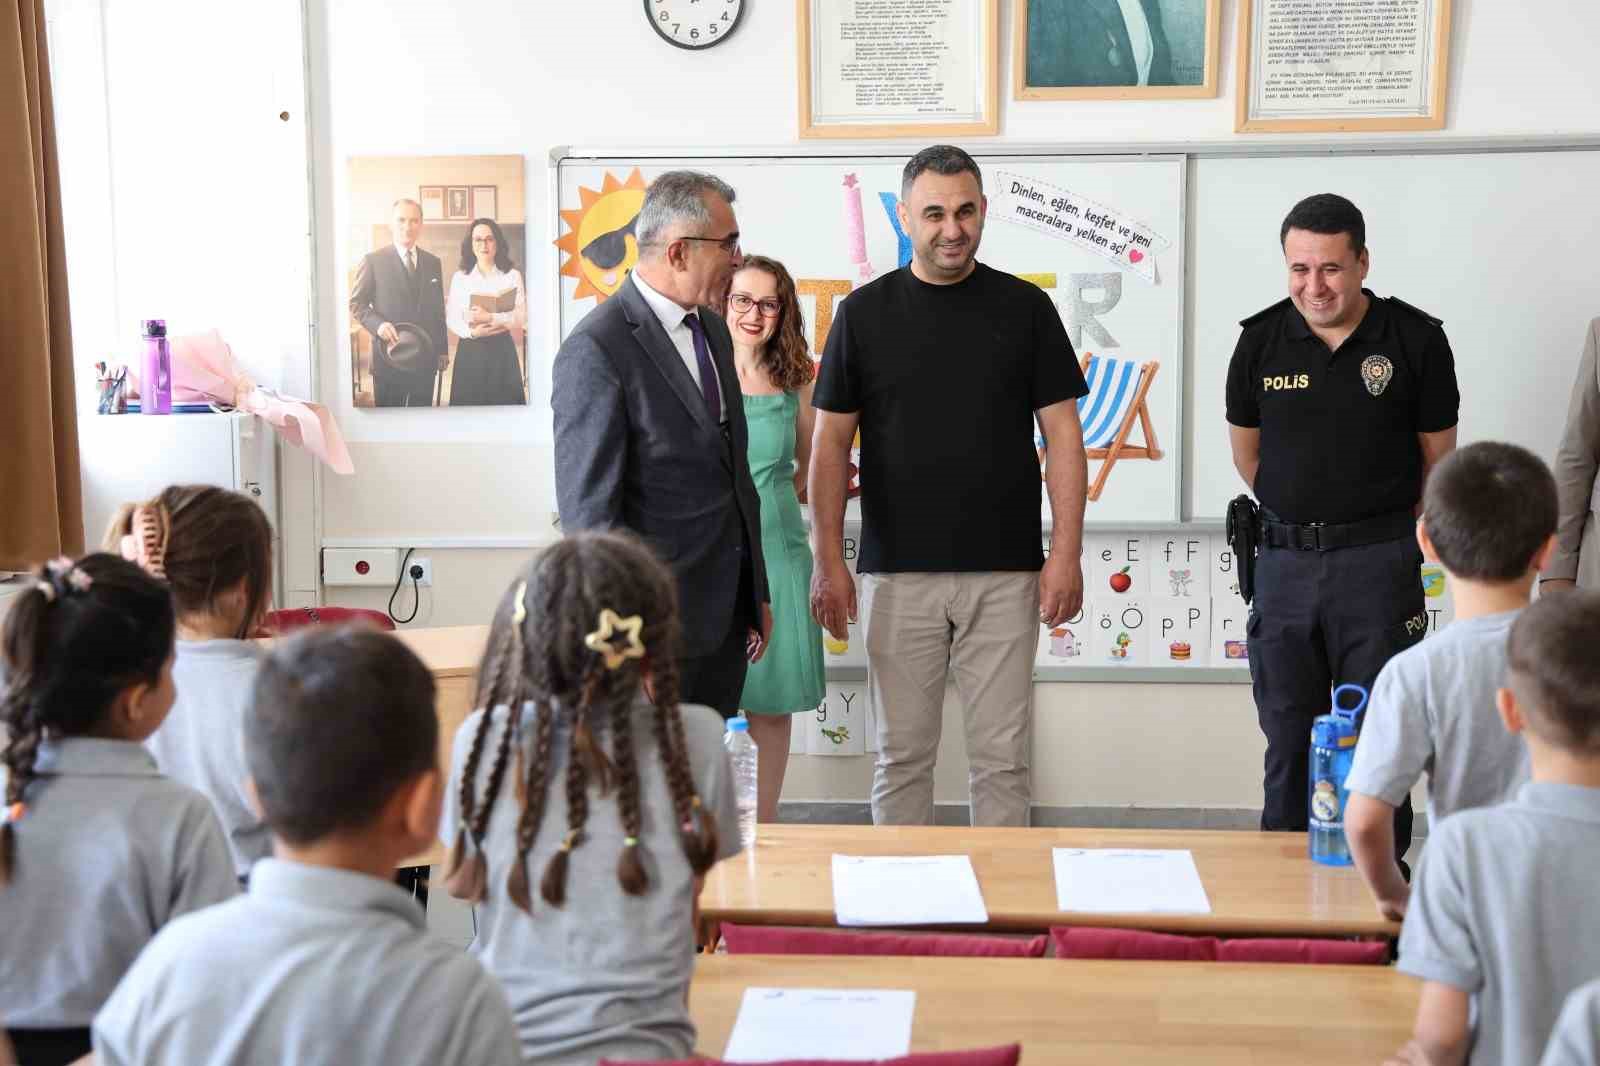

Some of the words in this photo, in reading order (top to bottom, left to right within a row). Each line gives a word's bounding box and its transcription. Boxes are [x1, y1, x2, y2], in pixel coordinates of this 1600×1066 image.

[660, 10, 670, 21] 8
[720, 10, 729, 21] 4
[671, 23, 681, 34] 7
[689, 28, 699, 39] 6
[709, 23, 718, 34] 5
[1010, 181, 1046, 205] Dinlen,
[1050, 197, 1080, 219] eğlen,
[1084, 207, 1116, 231] keşfet
[1118, 225, 1130, 237] ve
[1128, 232, 1152, 248] yeni
[1016, 206, 1073, 232] maceralara
[1073, 227, 1109, 248] yelken
[1110, 242, 1127, 255] aç!
[1101, 549, 1112, 562] e
[1127, 539, 1140, 562] E
[1163, 541, 1174, 563] f
[1187, 540, 1201, 563] F
[1219, 551, 1232, 572] g
[1100, 613, 1112, 629] ö
[1121, 602, 1143, 629] Ö
[1162, 617, 1174, 638] p
[1189, 607, 1201, 629] P
[1223, 619, 1233, 630] r
[840, 692, 856, 713] Y
